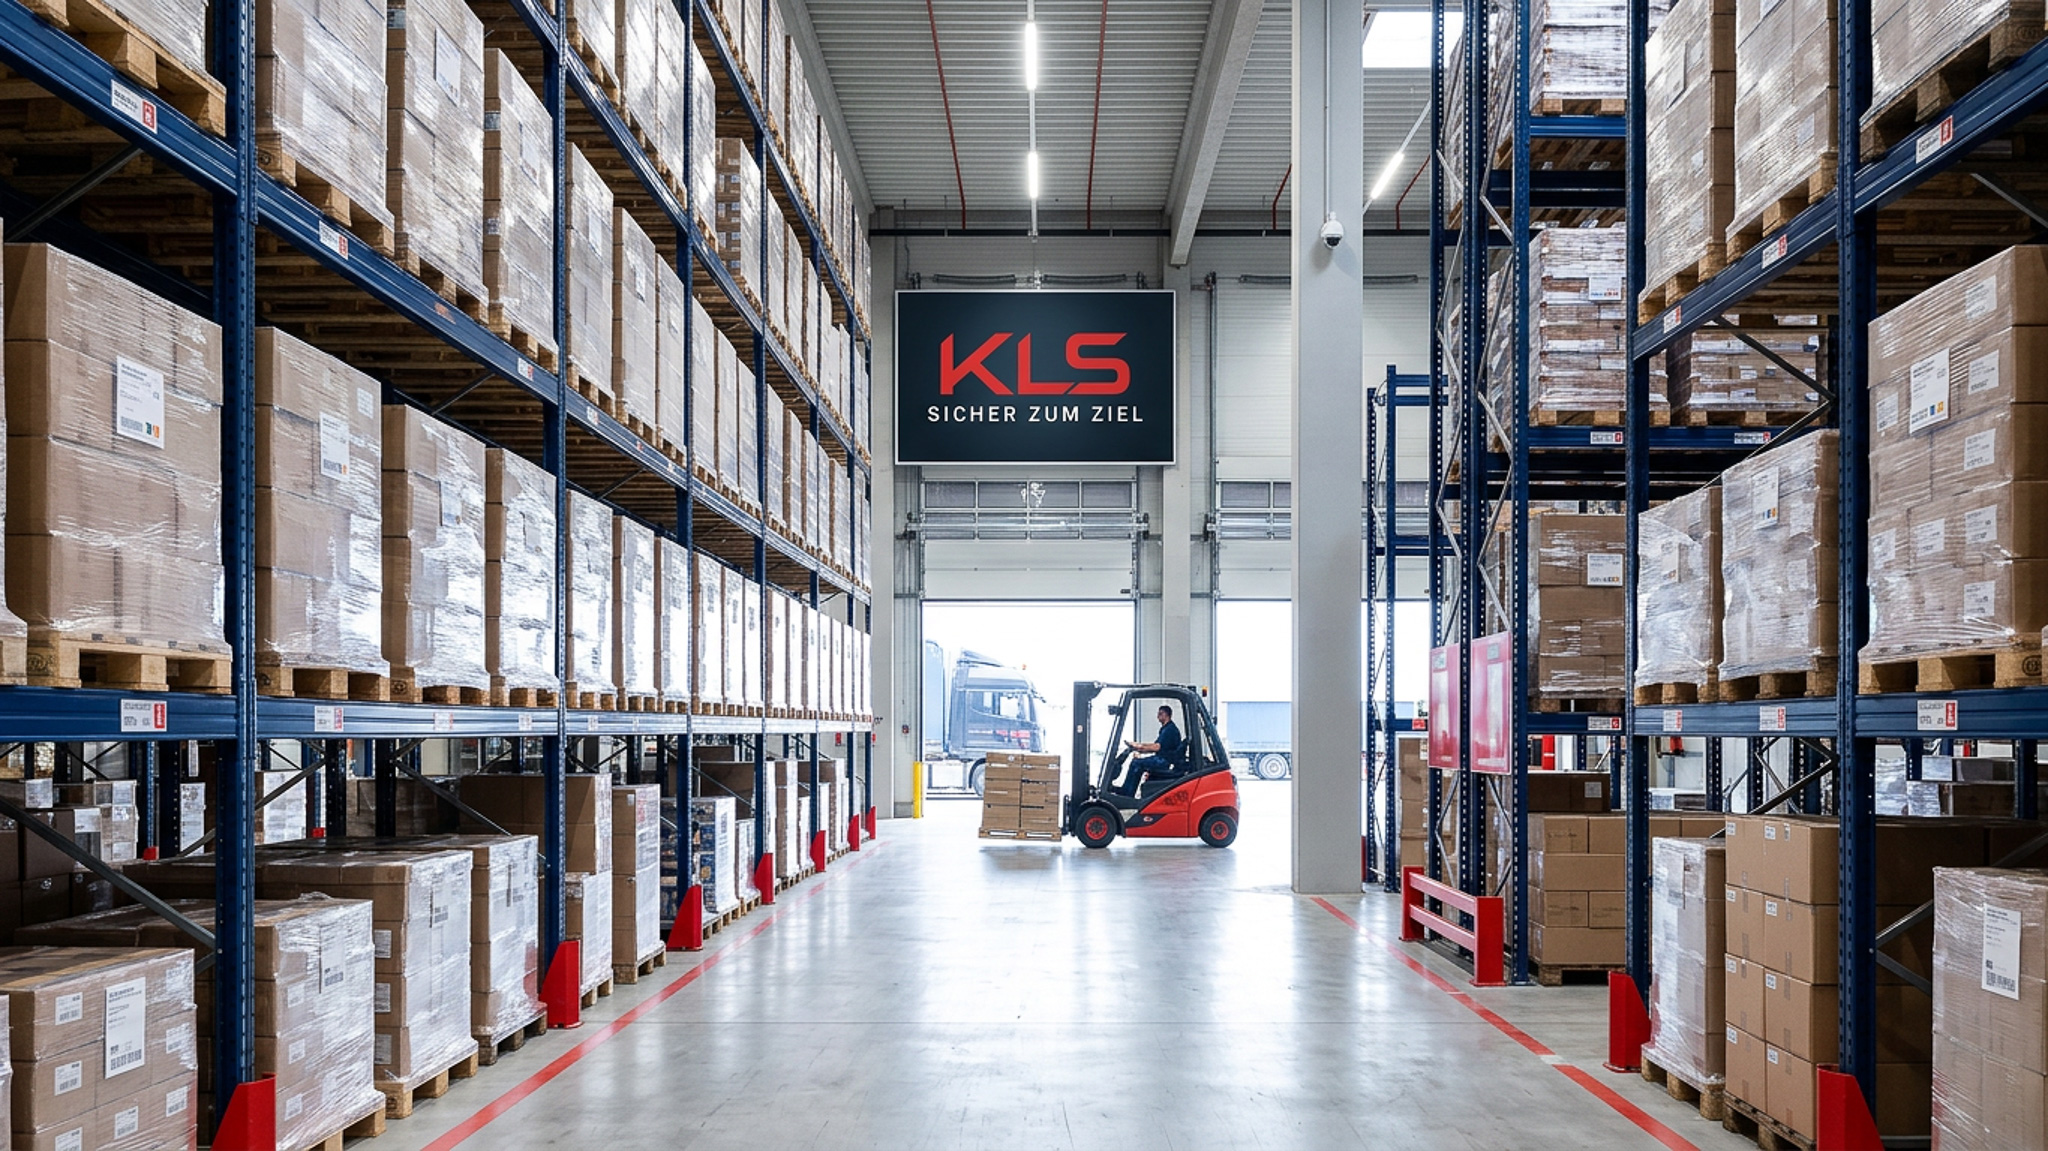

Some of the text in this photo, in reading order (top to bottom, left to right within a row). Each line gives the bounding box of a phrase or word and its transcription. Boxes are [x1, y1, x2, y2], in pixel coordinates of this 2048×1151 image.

[941, 333, 1130, 395] KLS
[928, 406, 1142, 421] SICHER ZUM ZIEL
